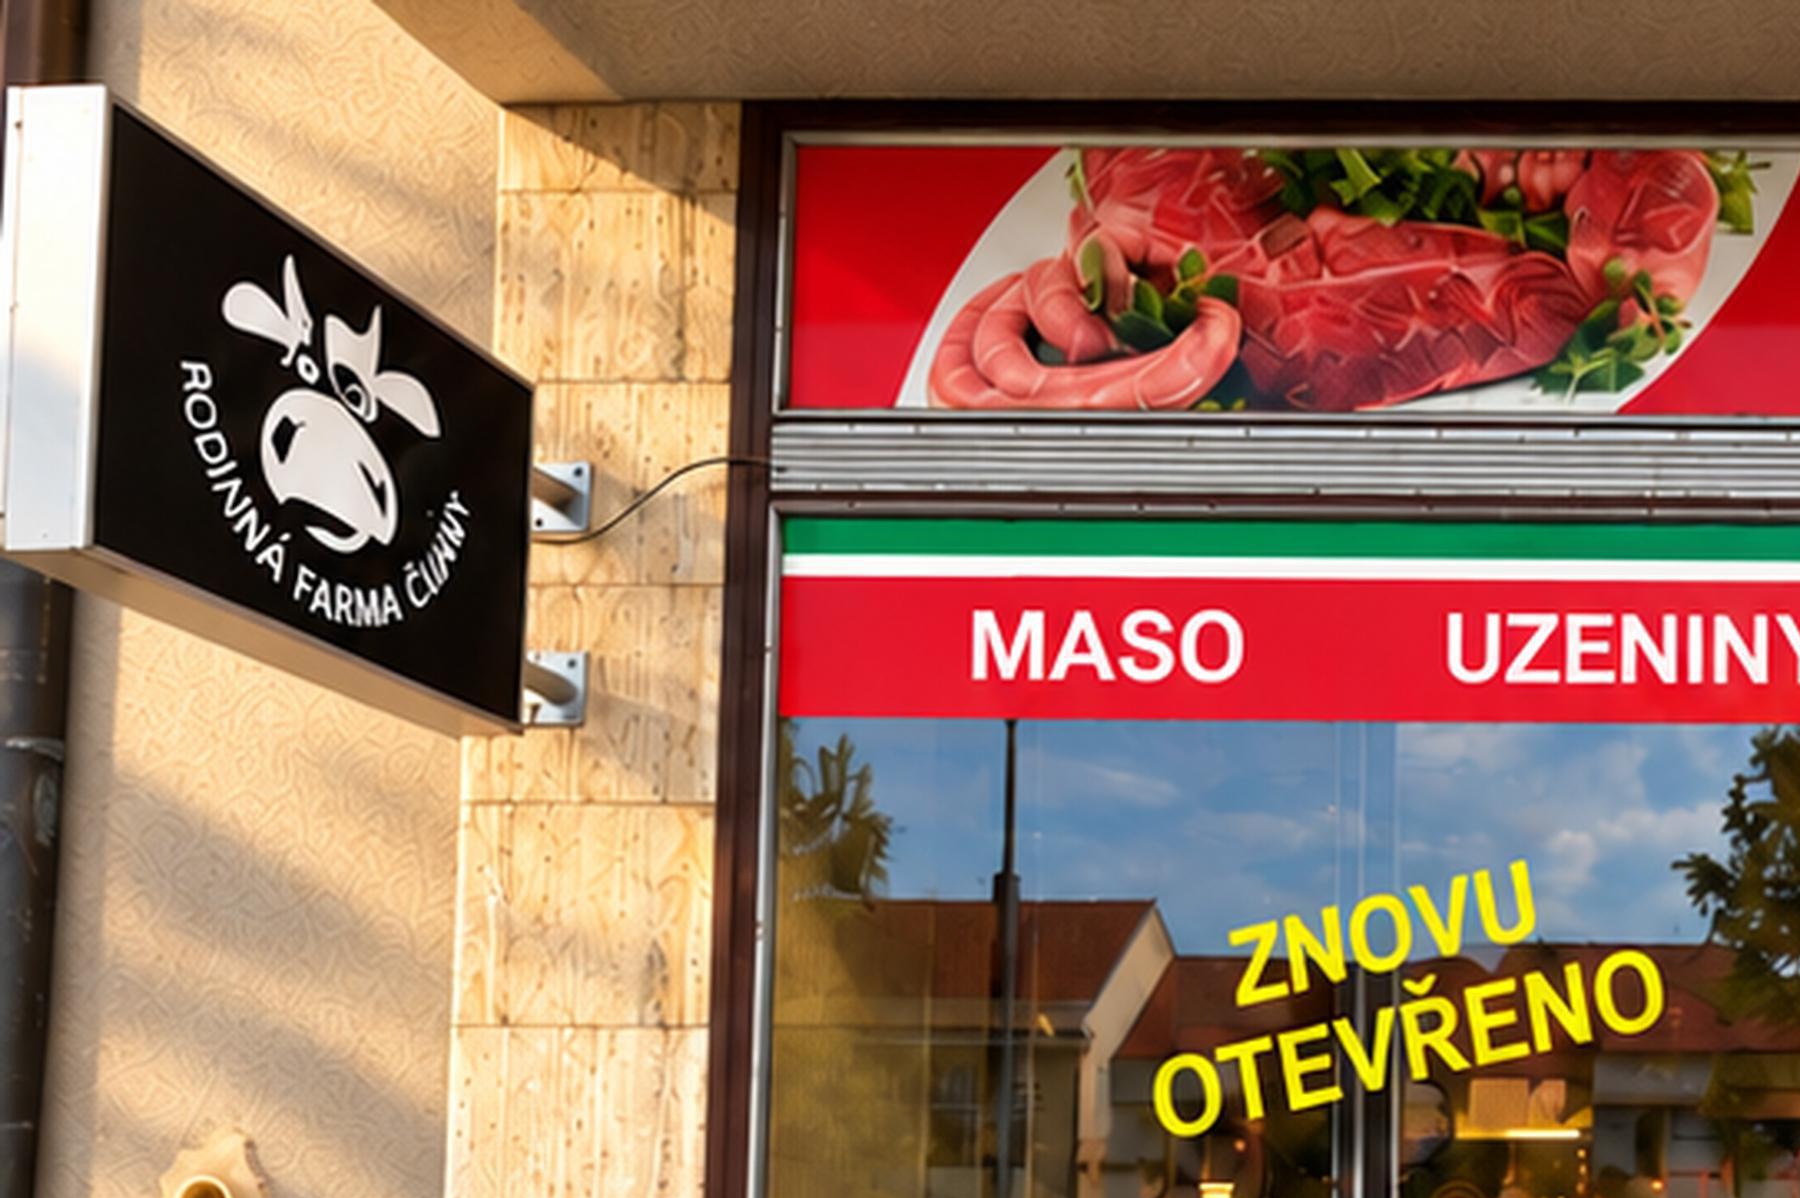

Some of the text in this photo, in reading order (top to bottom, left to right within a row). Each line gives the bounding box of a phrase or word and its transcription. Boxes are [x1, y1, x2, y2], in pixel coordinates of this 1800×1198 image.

[180, 360, 291, 583] RODINNÁ
[293, 564, 402, 627] FARMA
[971, 609, 1244, 683] MASO
[1230, 861, 1536, 1006] ZNOVU
[1153, 949, 1665, 1137] OTEVŘENO
